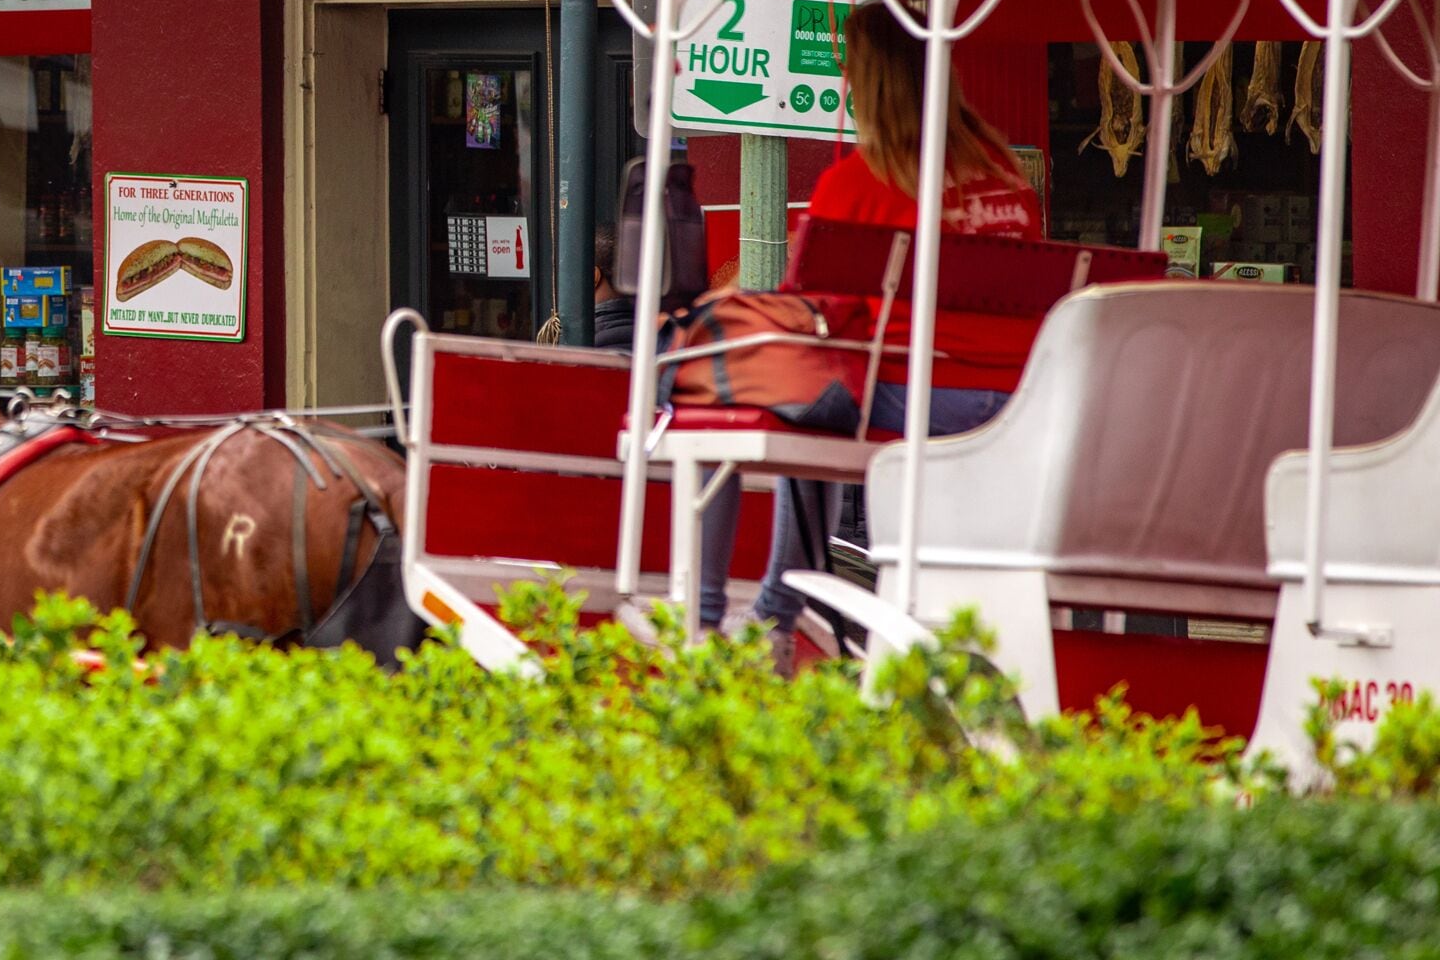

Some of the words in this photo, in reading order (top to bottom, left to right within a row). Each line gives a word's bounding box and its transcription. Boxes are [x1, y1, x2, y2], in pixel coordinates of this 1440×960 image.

[688, 43, 770, 78] HOUR
[118, 186, 137, 198] FOR
[140, 187, 169, 200] THREE
[173, 189, 235, 203] GENERATIONS
[113, 205, 137, 222] Home
[138, 205, 148, 227] of
[148, 206, 161, 222] the
[162, 207, 195, 230] Original
[197, 207, 239, 231] Muffuletta
[492, 246, 511, 255] open
[110, 308, 136, 321] IMITATED
[138, 310, 146, 322] BY
[181, 313, 199, 325] NEVER
[201, 313, 237, 327] DUPLICATED
